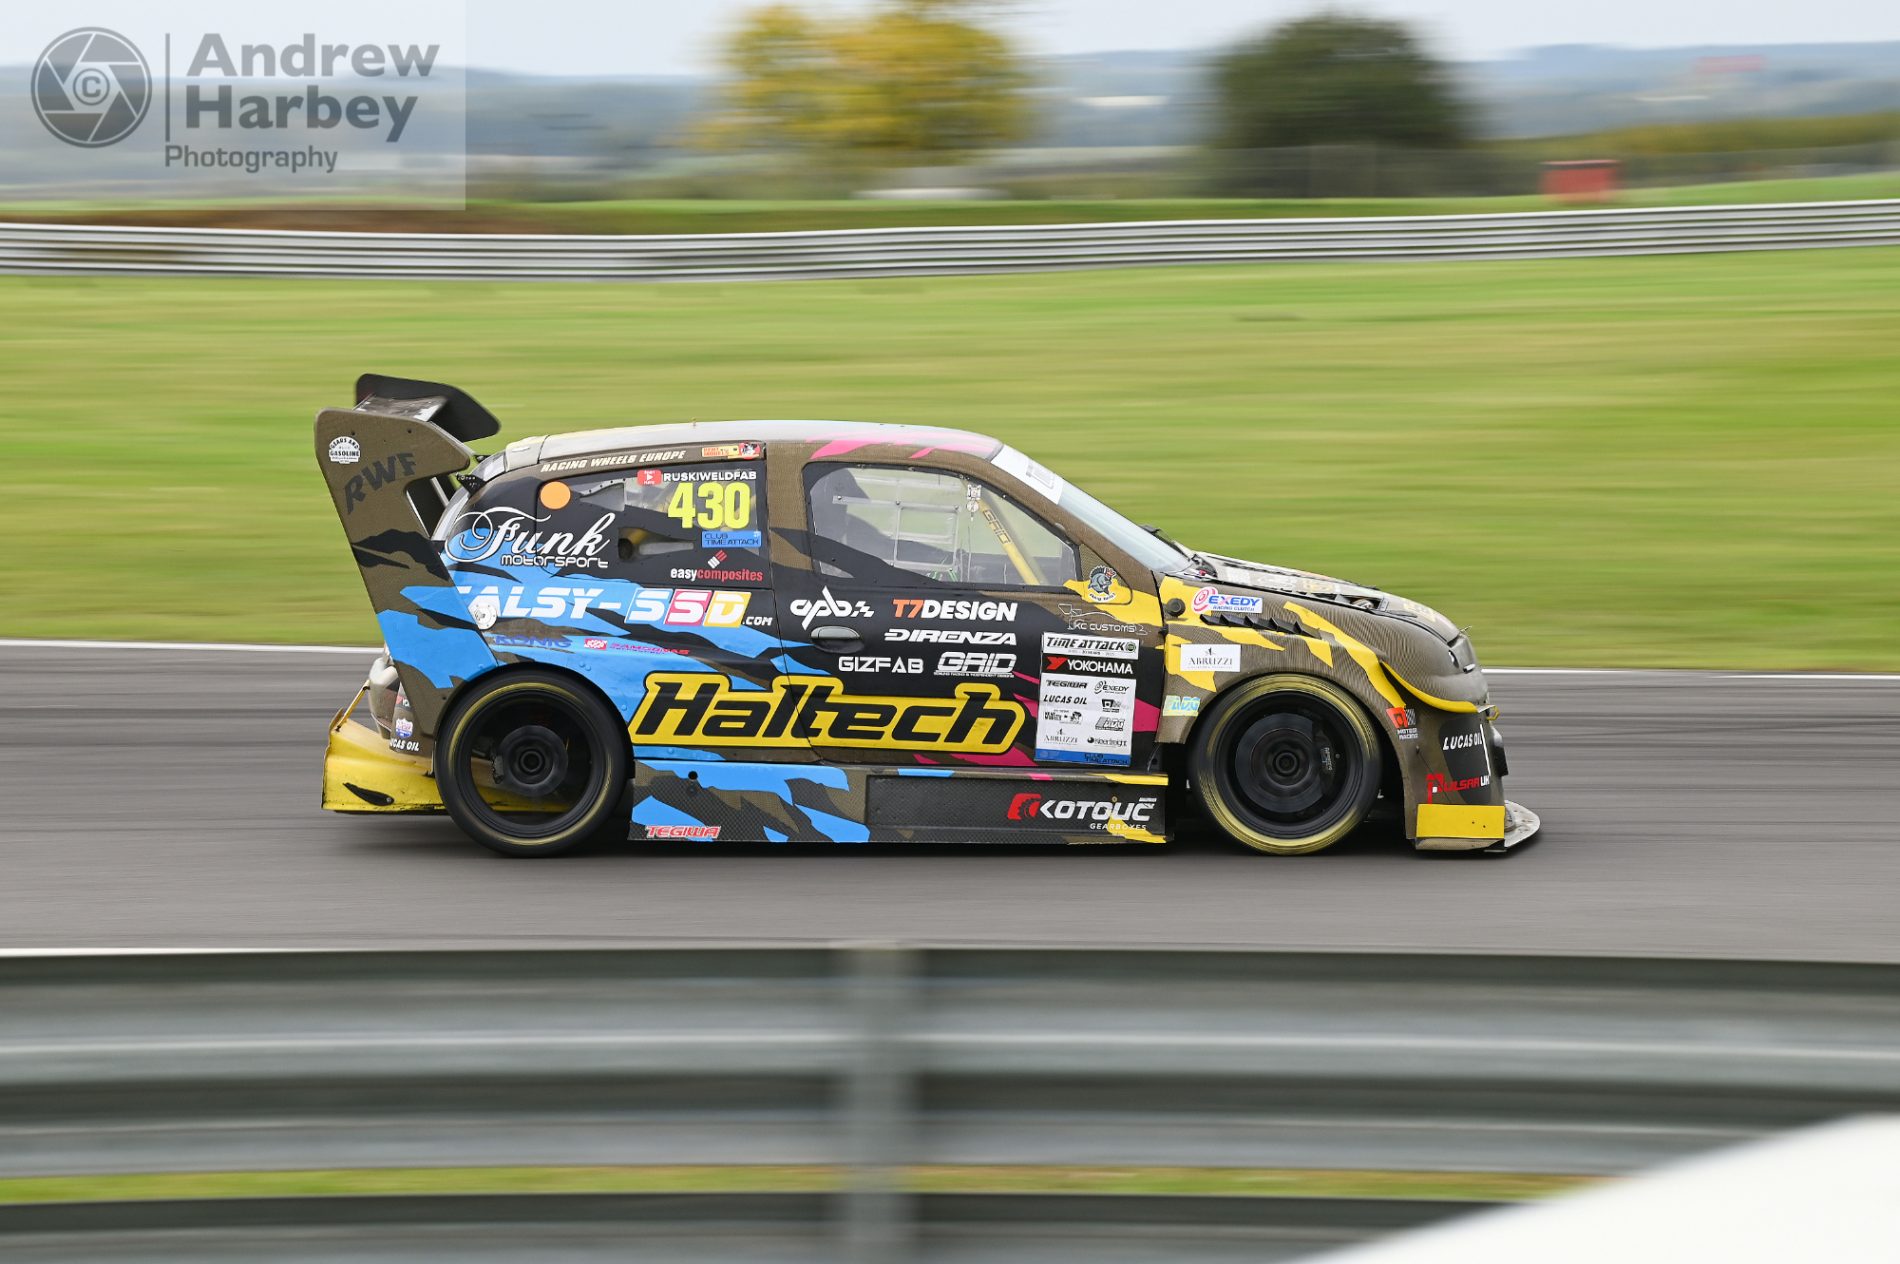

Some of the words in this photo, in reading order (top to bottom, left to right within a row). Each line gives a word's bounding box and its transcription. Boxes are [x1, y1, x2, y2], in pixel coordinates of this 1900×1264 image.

[541, 459, 588, 472] RACING
[590, 454, 637, 467] WHEELS
[639, 450, 687, 462] EUROPE
[663, 471, 757, 481] RUSKIWELDFAB
[344, 453, 416, 515] RWF
[668, 482, 751, 529] 430
[445, 506, 616, 562] Funk
[1208, 595, 1260, 606] EXEDY
[892, 599, 1018, 621] T7DESIGN
[1089, 623, 1136, 633] CUSTOMS
[884, 628, 1018, 646] DIRENZA
[1078, 639, 1125, 651] ATTACK
[838, 656, 924, 673] GIZFAB
[937, 651, 1018, 673] GRID
[1067, 660, 1134, 674] YOKOHAMA
[1188, 657, 1233, 665] ABRUZZI
[1046, 680, 1088, 689] TEGIWA
[1043, 694, 1072, 704] LUCAS
[1073, 696, 1088, 705] OIL
[635, 682, 1001, 744] Haltech
[406, 741, 420, 752] OIL
[1443, 733, 1473, 750] LUCAS
[1473, 732, 1482, 746] OIL
[645, 825, 721, 839] TEGIWA
[1090, 823, 1147, 831] GEARBOXES
